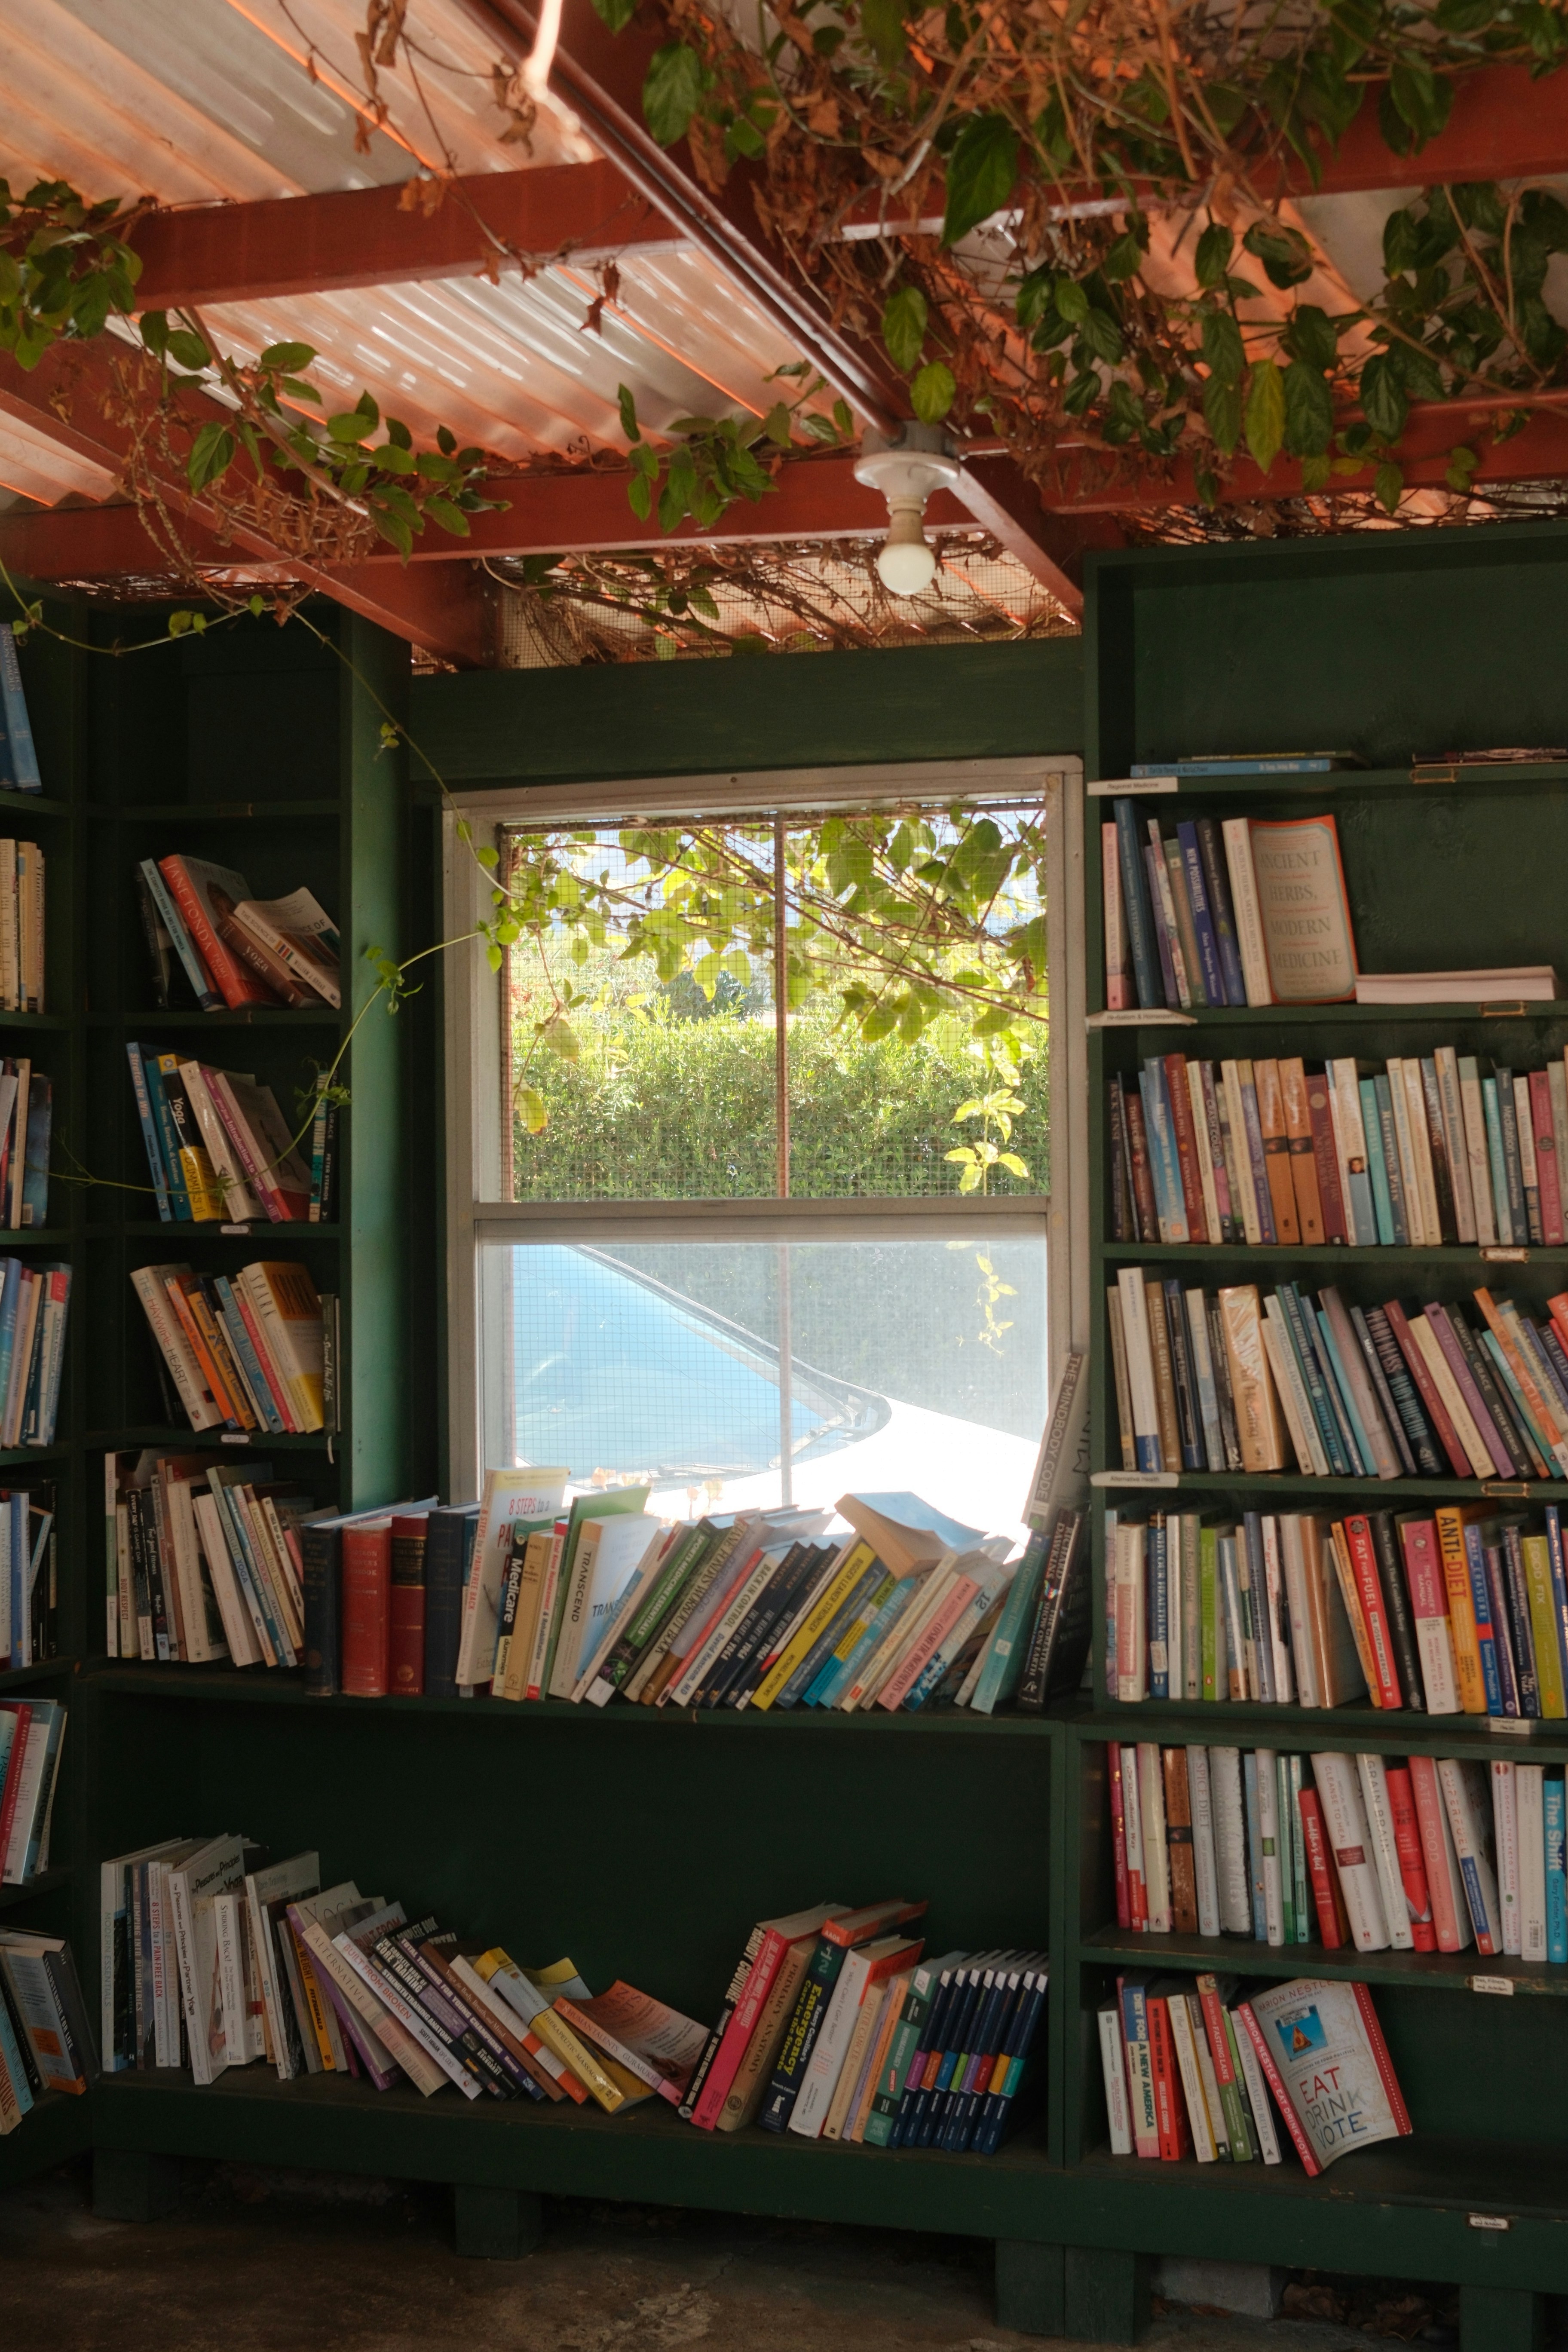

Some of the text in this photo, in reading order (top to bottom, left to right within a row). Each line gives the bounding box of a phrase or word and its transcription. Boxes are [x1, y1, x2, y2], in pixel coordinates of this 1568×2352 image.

[1185, 848, 1205, 913] NEW POSSIBILITIES
[1256, 848, 1322, 872] ANCIENT
[163, 861, 215, 952] JANE FONDA
[1269, 884, 1317, 901] HERBS,
[1270, 917, 1332, 936] MODERN
[240, 943, 270, 977] yoga
[1271, 948, 1342, 969] MEDICINE
[129, 1053, 150, 1118] Stretch to Win
[171, 1097, 187, 1124] Yoga
[1501, 1105, 1518, 1153] Meditation
[248, 1274, 277, 1319] SPARK
[137, 1275, 189, 1385] THE HAYWIRE HEART
[1452, 1316, 1492, 1391] GRAVITY GRACE
[1276, 1323, 1316, 1440] MARGINAL TO MAINSTREAM
[1035, 1355, 1081, 1500] THE MINDBODY CODE
[223, 1522, 250, 1584] INSIGHT YOGA
[550, 1554, 559, 1570] Knee
[553, 1537, 562, 1553] Total
[1044, 1522, 1066, 1580] DAWKINS
[1054, 1526, 1074, 1580] RICHARD
[1438, 1515, 1469, 1600] ANTI-DIET
[119, 1578, 129, 1620] BODY RESPECT
[502, 1558, 524, 1623] Medicare
[542, 1570, 557, 1611] Replacement
[570, 1550, 592, 1623] TRANSCEND
[723, 1562, 772, 1629] BACK IN CONTROL
[807, 1556, 864, 1634] BIGGER LEANER STRONGER
[1354, 1539, 1367, 1559] FAT
[1362, 1576, 1377, 1608] FUEL
[1381, 1530, 1406, 1632] The Family That Couldn't Sleep
[1415, 1573, 1429, 1606] MANUAL
[1423, 1565, 1436, 1614] THE OWNER'S
[1467, 1534, 1488, 1618] PAIN ERASURE
[1529, 1543, 1547, 1605] FOOD FIX
[535, 1617, 548, 1660] Rehabilitation
[1370, 1613, 1390, 1685] DR JOSEPH MERCOLA
[1194, 1762, 1211, 1830] SPICE DIET
[1323, 1765, 1346, 1844] CLEANSE TO HEAL
[1416, 1773, 1440, 1862] FATE FOOD
[1442, 1769, 1469, 1855] SUPERFUEL
[1546, 1795, 1563, 1871] The Shift
[174, 1891, 184, 1920] Pleasures
[1550, 1878, 1559, 1895] Gary
[1552, 1896, 1560, 1919] Foster,
[133, 1902, 141, 1935] JUMPING
[151, 1909, 159, 1929] STEPS
[178, 1930, 190, 1959] Principles
[219, 1905, 232, 1962] STRIKING BACK!
[135, 1959, 143, 2012] PLYOMETRICS
[153, 1945, 162, 1978] PAIN-FREE
[184, 1965, 194, 1994] Partner
[298, 1949, 313, 1980] WEIGHT
[342, 1941, 412, 2021] BUILT FROM BROKEN
[374, 1941, 424, 1995] CORE TRAINING
[381, 1937, 428, 1987] THE COMPLETE BOOK OF
[723, 1928, 766, 2004] RANDY COUTURE
[154, 1981, 163, 1998] BACK
[187, 1996, 197, 2015] Yoga
[309, 1988, 324, 2031] FITZGERALD
[400, 1937, 504, 2055] TOTAL TRAINING FOR YOUNG CHAMPIONS
[776, 1979, 812, 2071] Care in the Streets
[780, 1982, 823, 2077] Emergency
[798, 2004, 823, 2063] Nancy Caroline's
[1133, 1994, 1146, 2040] DIET FOR
[1206, 1995, 1215, 2008] Life
[1212, 2025, 1224, 2058] FASTING
[1219, 2058, 1229, 2079] LANE
[1139, 2053, 1150, 2078] NEW
[1238, 2031, 1271, 2142] THE NEW HEALTH RULES
[1242, 2008, 1310, 2162] MARION NESTLE EAT DRINK VOTE
[1299, 2066, 1340, 2104] EAT
[1141, 2080, 1155, 2128] AMERICA
[1305, 2086, 1368, 2128] DRINK
[1315, 2110, 1368, 2150] VOTE
